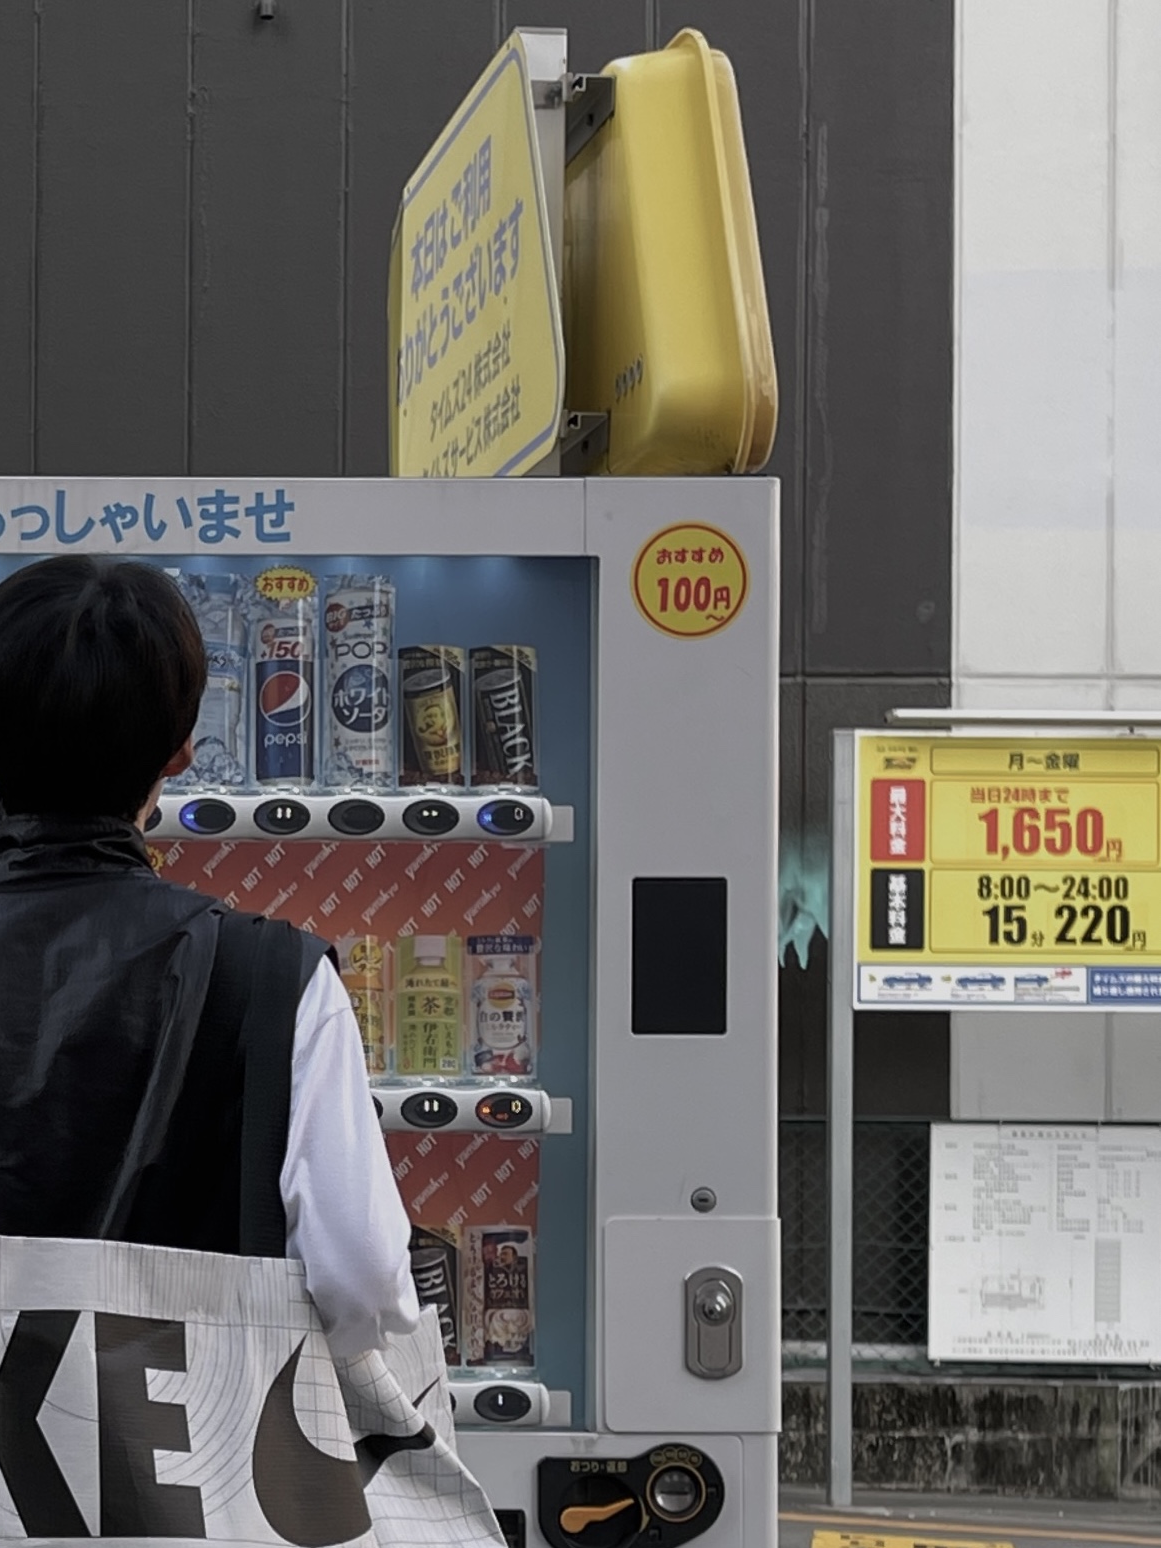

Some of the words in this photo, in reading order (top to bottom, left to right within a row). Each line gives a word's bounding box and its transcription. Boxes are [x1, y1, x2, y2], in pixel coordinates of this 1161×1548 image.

[410, 132, 493, 303] 本日はご利用
[656, 546, 725, 565] おすすめ
[262, 577, 310, 593] おすすめ
[264, 731, 307, 747] pepsi
[490, 685, 533, 779] BLACK
[264, 841, 286, 868] HOT
[365, 844, 387, 869] HOT
[467, 844, 489, 869] HOT
[241, 867, 263, 892] HOT
[342, 868, 363, 893] HOT
[444, 868, 465, 893] HOT
[224, 890, 240, 909] OT
[319, 892, 341, 917] HOT
[420, 892, 442, 918] HOT
[422, 996, 440, 1015] 茶
[415, 1133, 438, 1157] HOT
[493, 1159, 516, 1184] HOT
[470, 1182, 492, 1207] HOT
